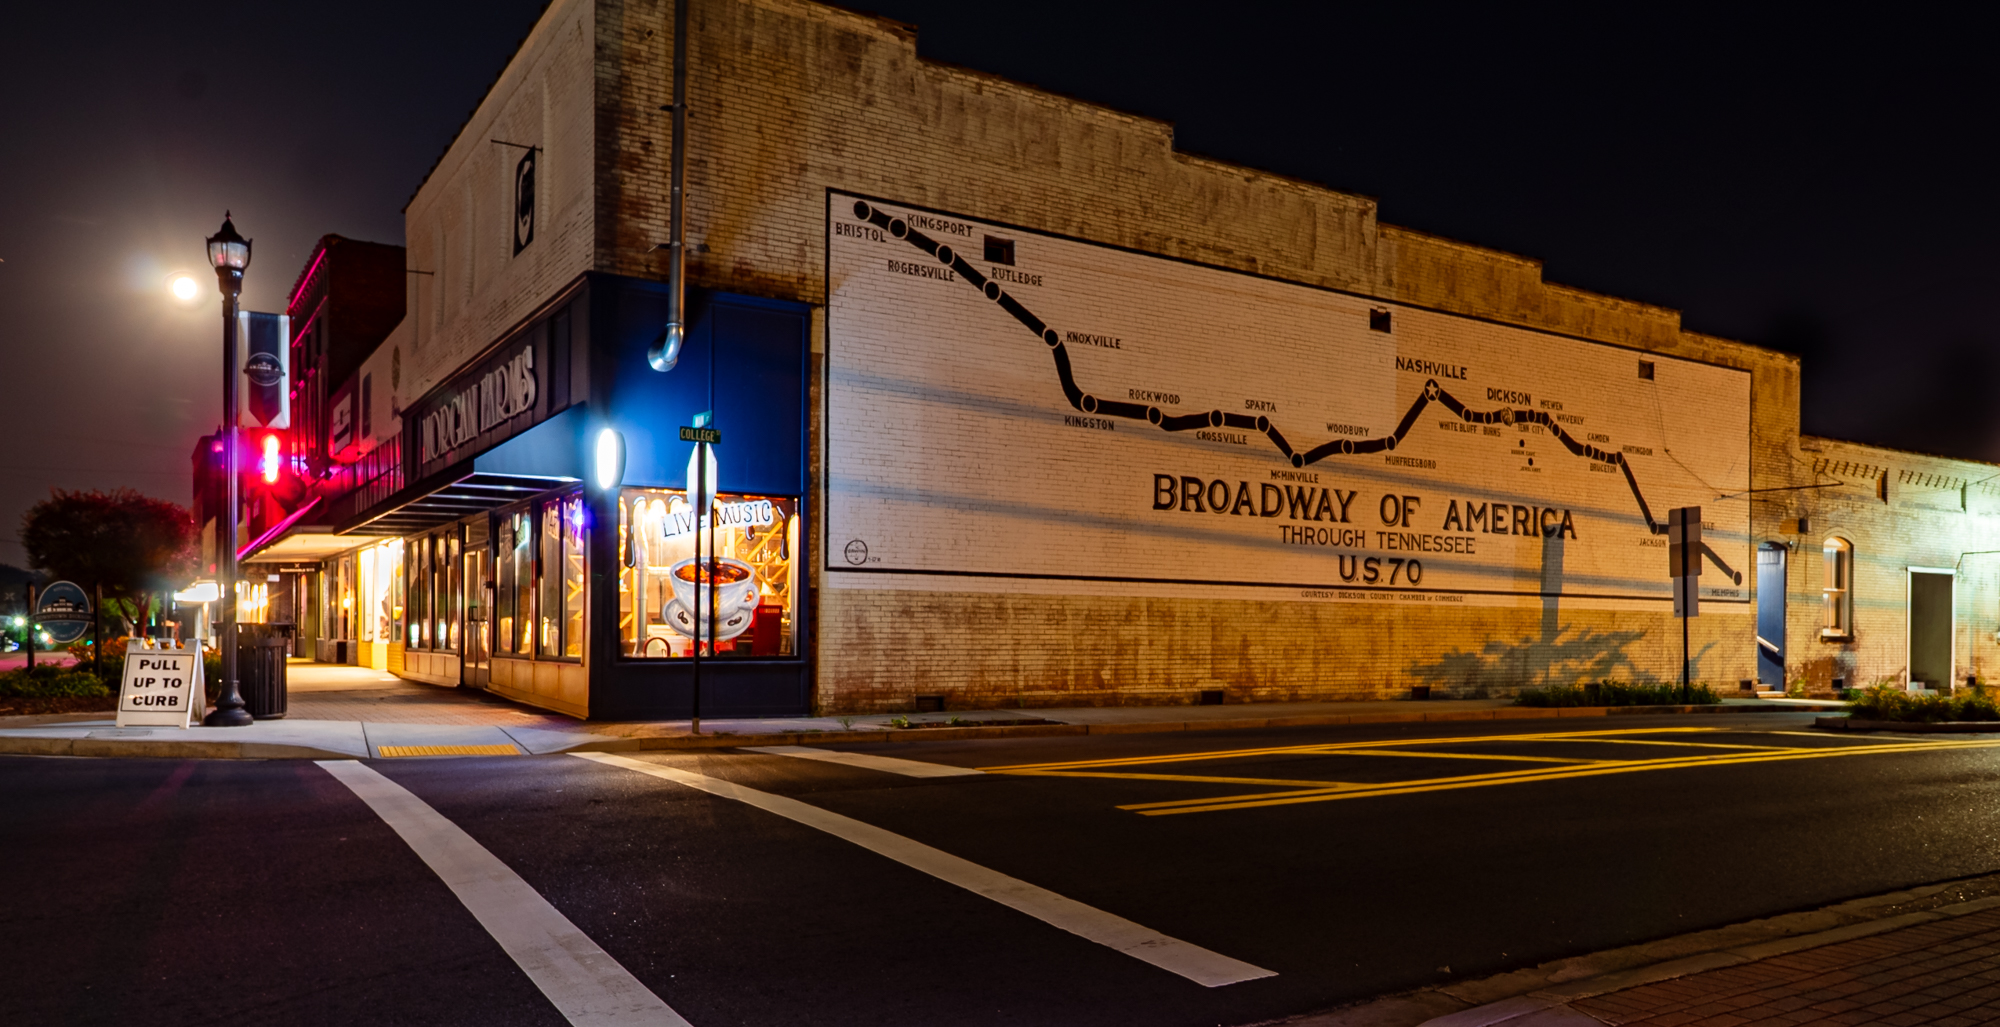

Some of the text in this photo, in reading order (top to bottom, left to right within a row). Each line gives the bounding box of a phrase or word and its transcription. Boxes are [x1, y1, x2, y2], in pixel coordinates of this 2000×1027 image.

[835, 221, 887, 243] BRISTOL
[907, 213, 973, 238] KINGSPORT
[887, 259, 955, 282] ROGERSVILLE
[991, 266, 1043, 287] RUTLEDGE
[1066, 331, 1121, 350] KNOXVILLE
[1395, 355, 1468, 381] NASHVILLE
[1128, 388, 1181, 405] ROCKWOOD
[1487, 387, 1532, 406] DICKSON
[1245, 399, 1277, 413] SPARTA
[1064, 415, 1115, 431] KINGSTON
[1556, 413, 1585, 425] WAVERLY
[680, 428, 715, 442] COLLEGE
[1326, 422, 1370, 437] WOODBURY
[1439, 421, 1477, 434] WHITE BLUFF
[1483, 426, 1501, 437] BURNS
[1531, 425, 1545, 435] CITY
[1196, 430, 1248, 445] CROSSVILLE
[1587, 432, 1610, 443] CAMDEN
[1385, 455, 1437, 470] MURFREESBORO
[1590, 462, 1617, 474] BRUCETON
[714, 502, 770, 526] MUSIC
[1152, 473, 1578, 540] BROADWAY OF AMERICA
[1278, 524, 1476, 555] THROUGH TENNESSEE
[1639, 538, 1665, 547] JACKSON
[1301, 590, 1334, 599] COURTESY
[1338, 591, 1365, 600] DICKSON
[1370, 593, 1394, 601] COUNTY
[1399, 593, 1426, 602] CHAMBER
[1434, 595, 1463, 603] COMMERCE
[1711, 588, 1739, 598] MEMPHIS
[139, 659, 181, 670] PULL
[133, 677, 182, 689] UP TO
[132, 695, 179, 707] CURB
